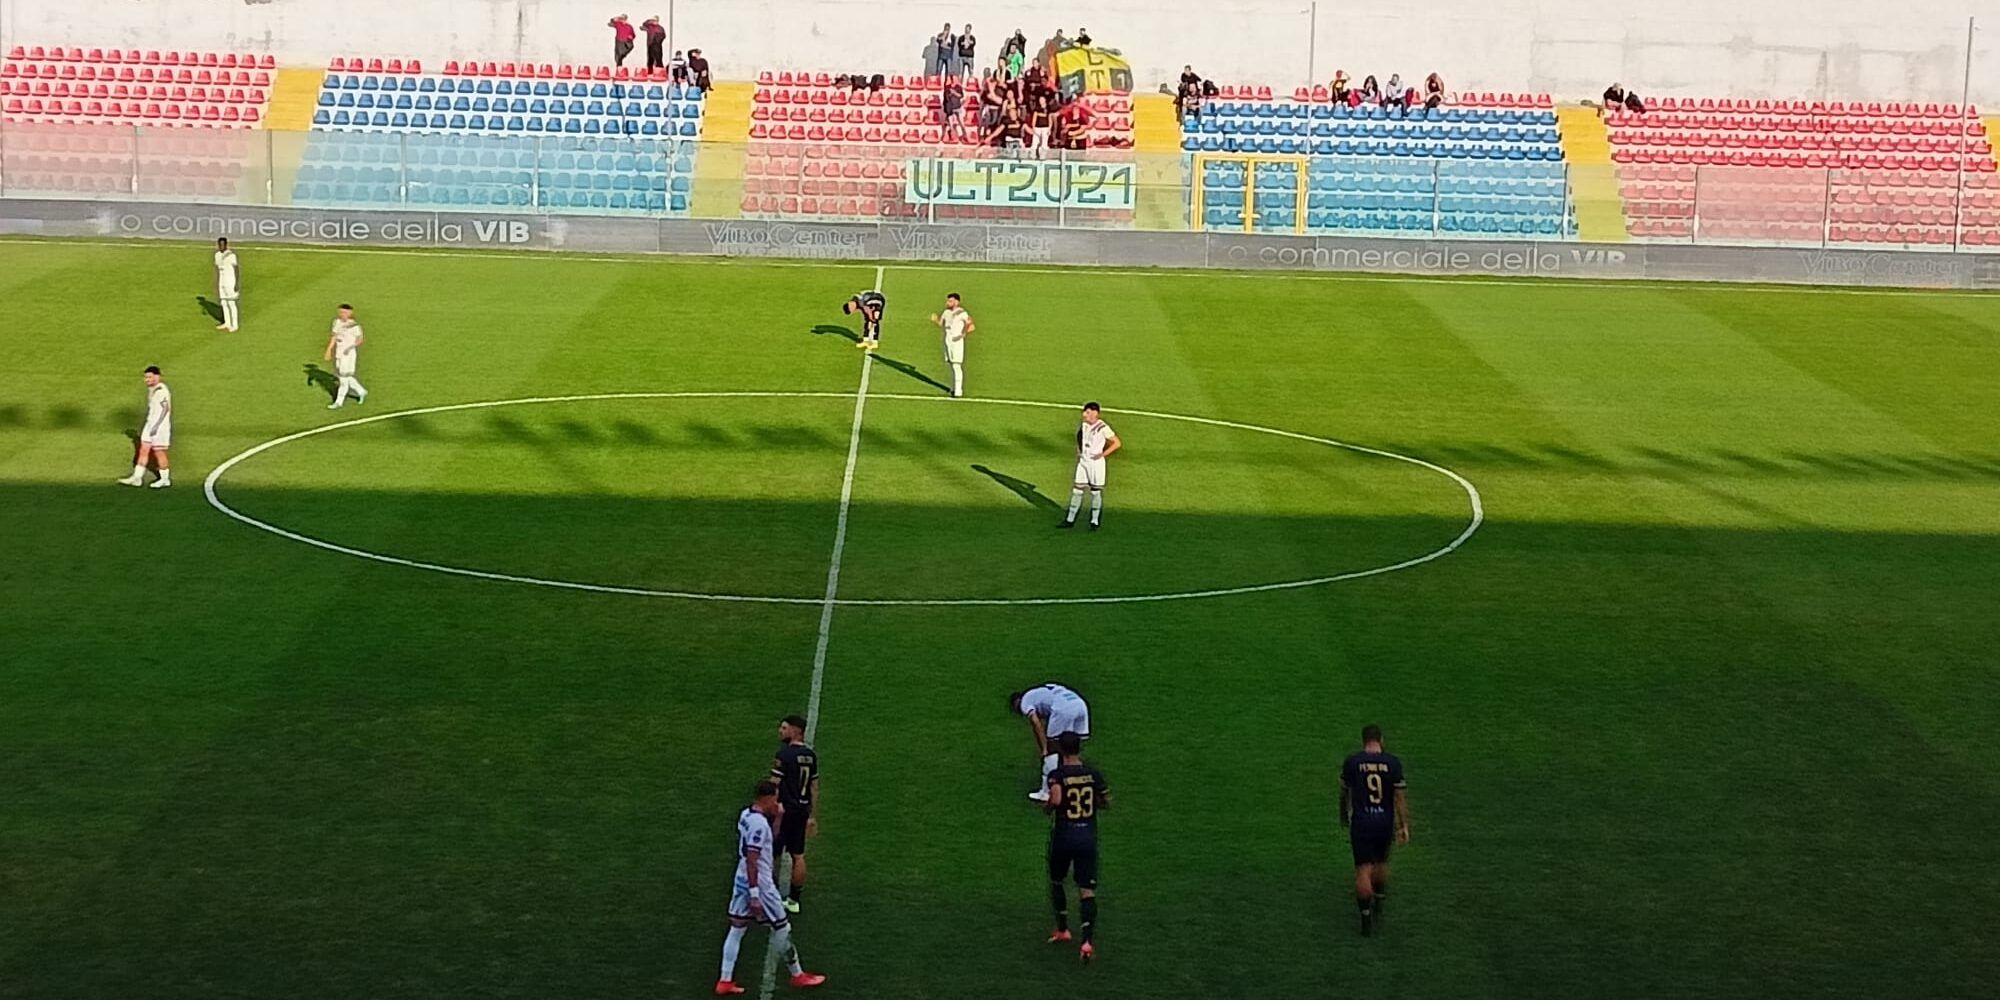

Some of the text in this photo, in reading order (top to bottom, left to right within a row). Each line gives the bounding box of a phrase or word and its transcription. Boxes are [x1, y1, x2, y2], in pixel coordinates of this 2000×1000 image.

[152, 214, 370, 240] commerciale
[380, 217, 462, 242] della
[472, 220, 530, 243] VIB
[1259, 246, 1470, 269] commerciale
[1480, 246, 1560, 271] della
[799, 766, 810, 796] 7
[1366, 773, 1383, 804] 9
[1066, 786, 1094, 819] 33
